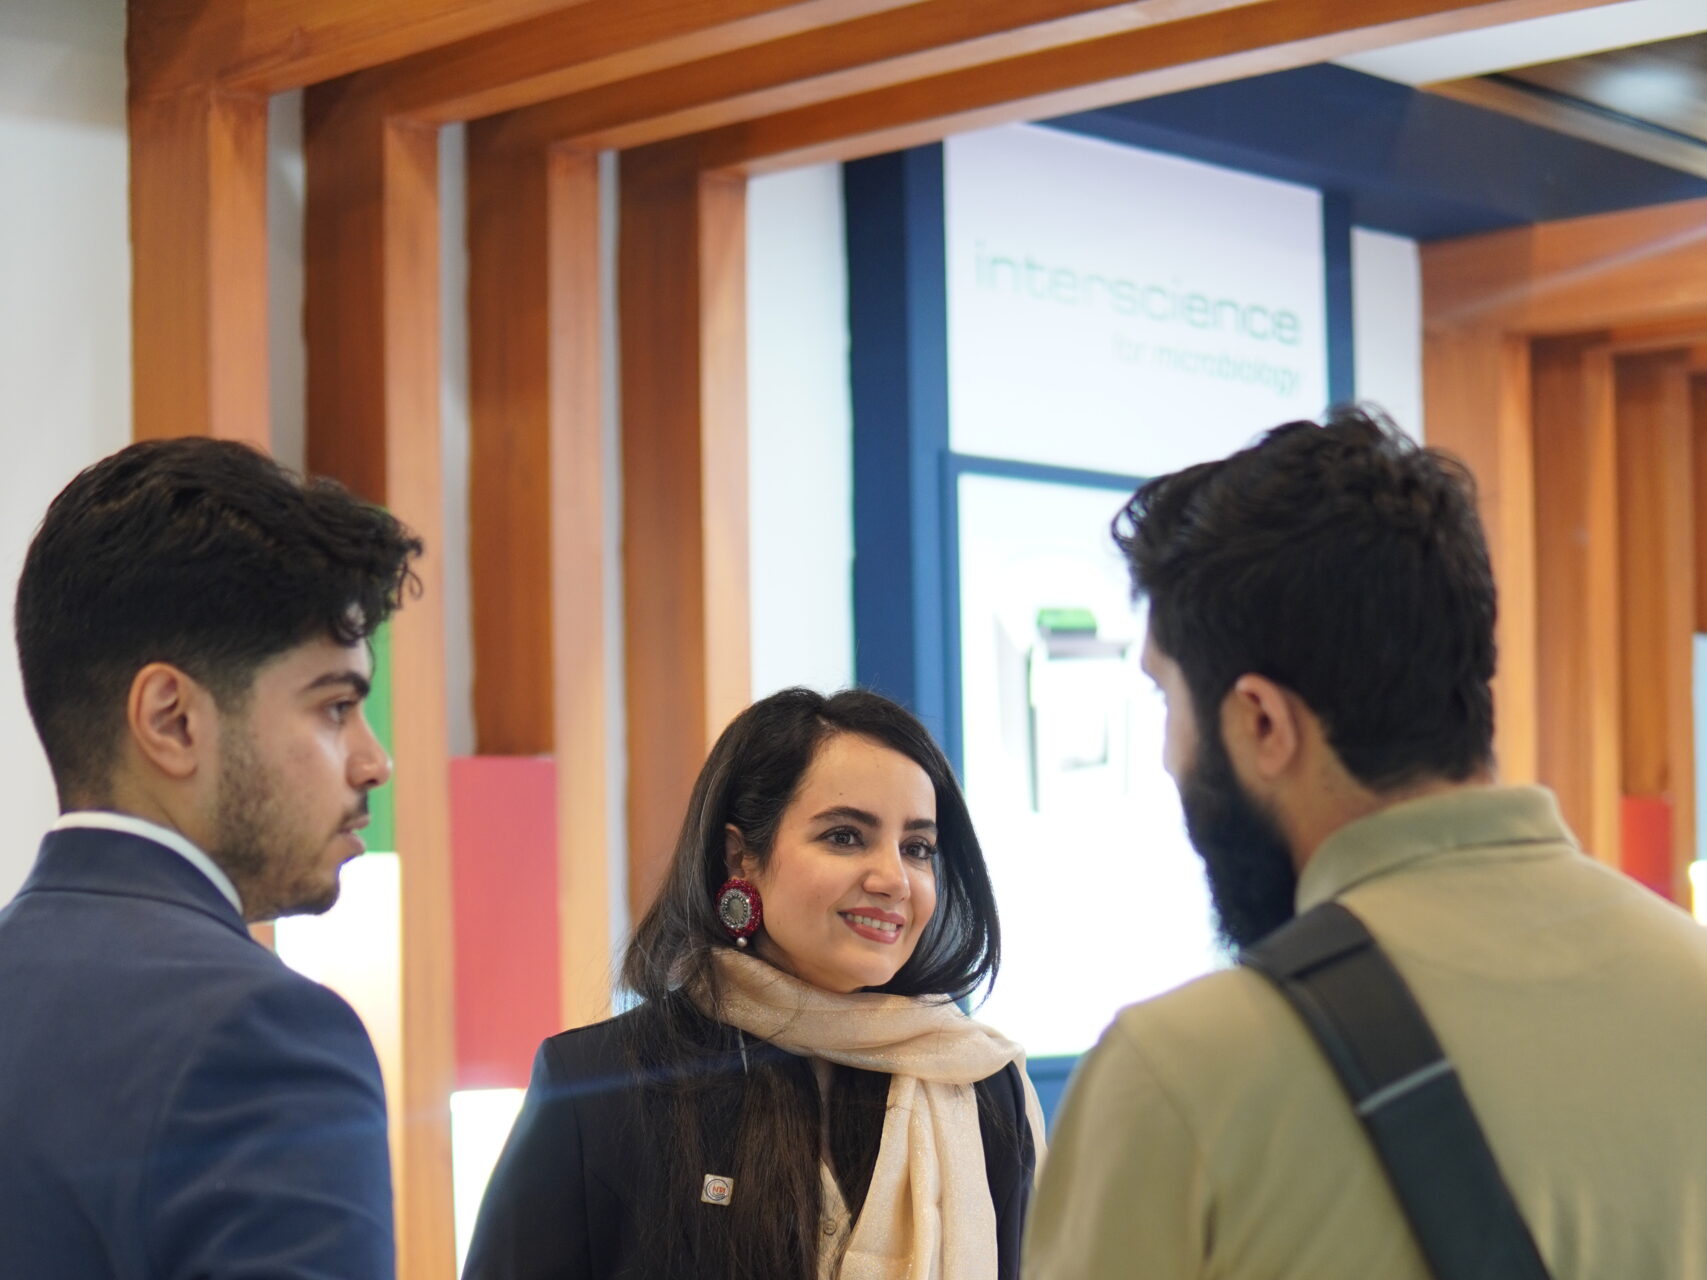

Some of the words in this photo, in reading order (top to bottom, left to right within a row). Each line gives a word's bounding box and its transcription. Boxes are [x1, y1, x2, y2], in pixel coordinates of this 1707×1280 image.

[975, 239, 1300, 345] interscience
[1113, 328, 1145, 361] for
[1153, 345, 1301, 397] microbiology
